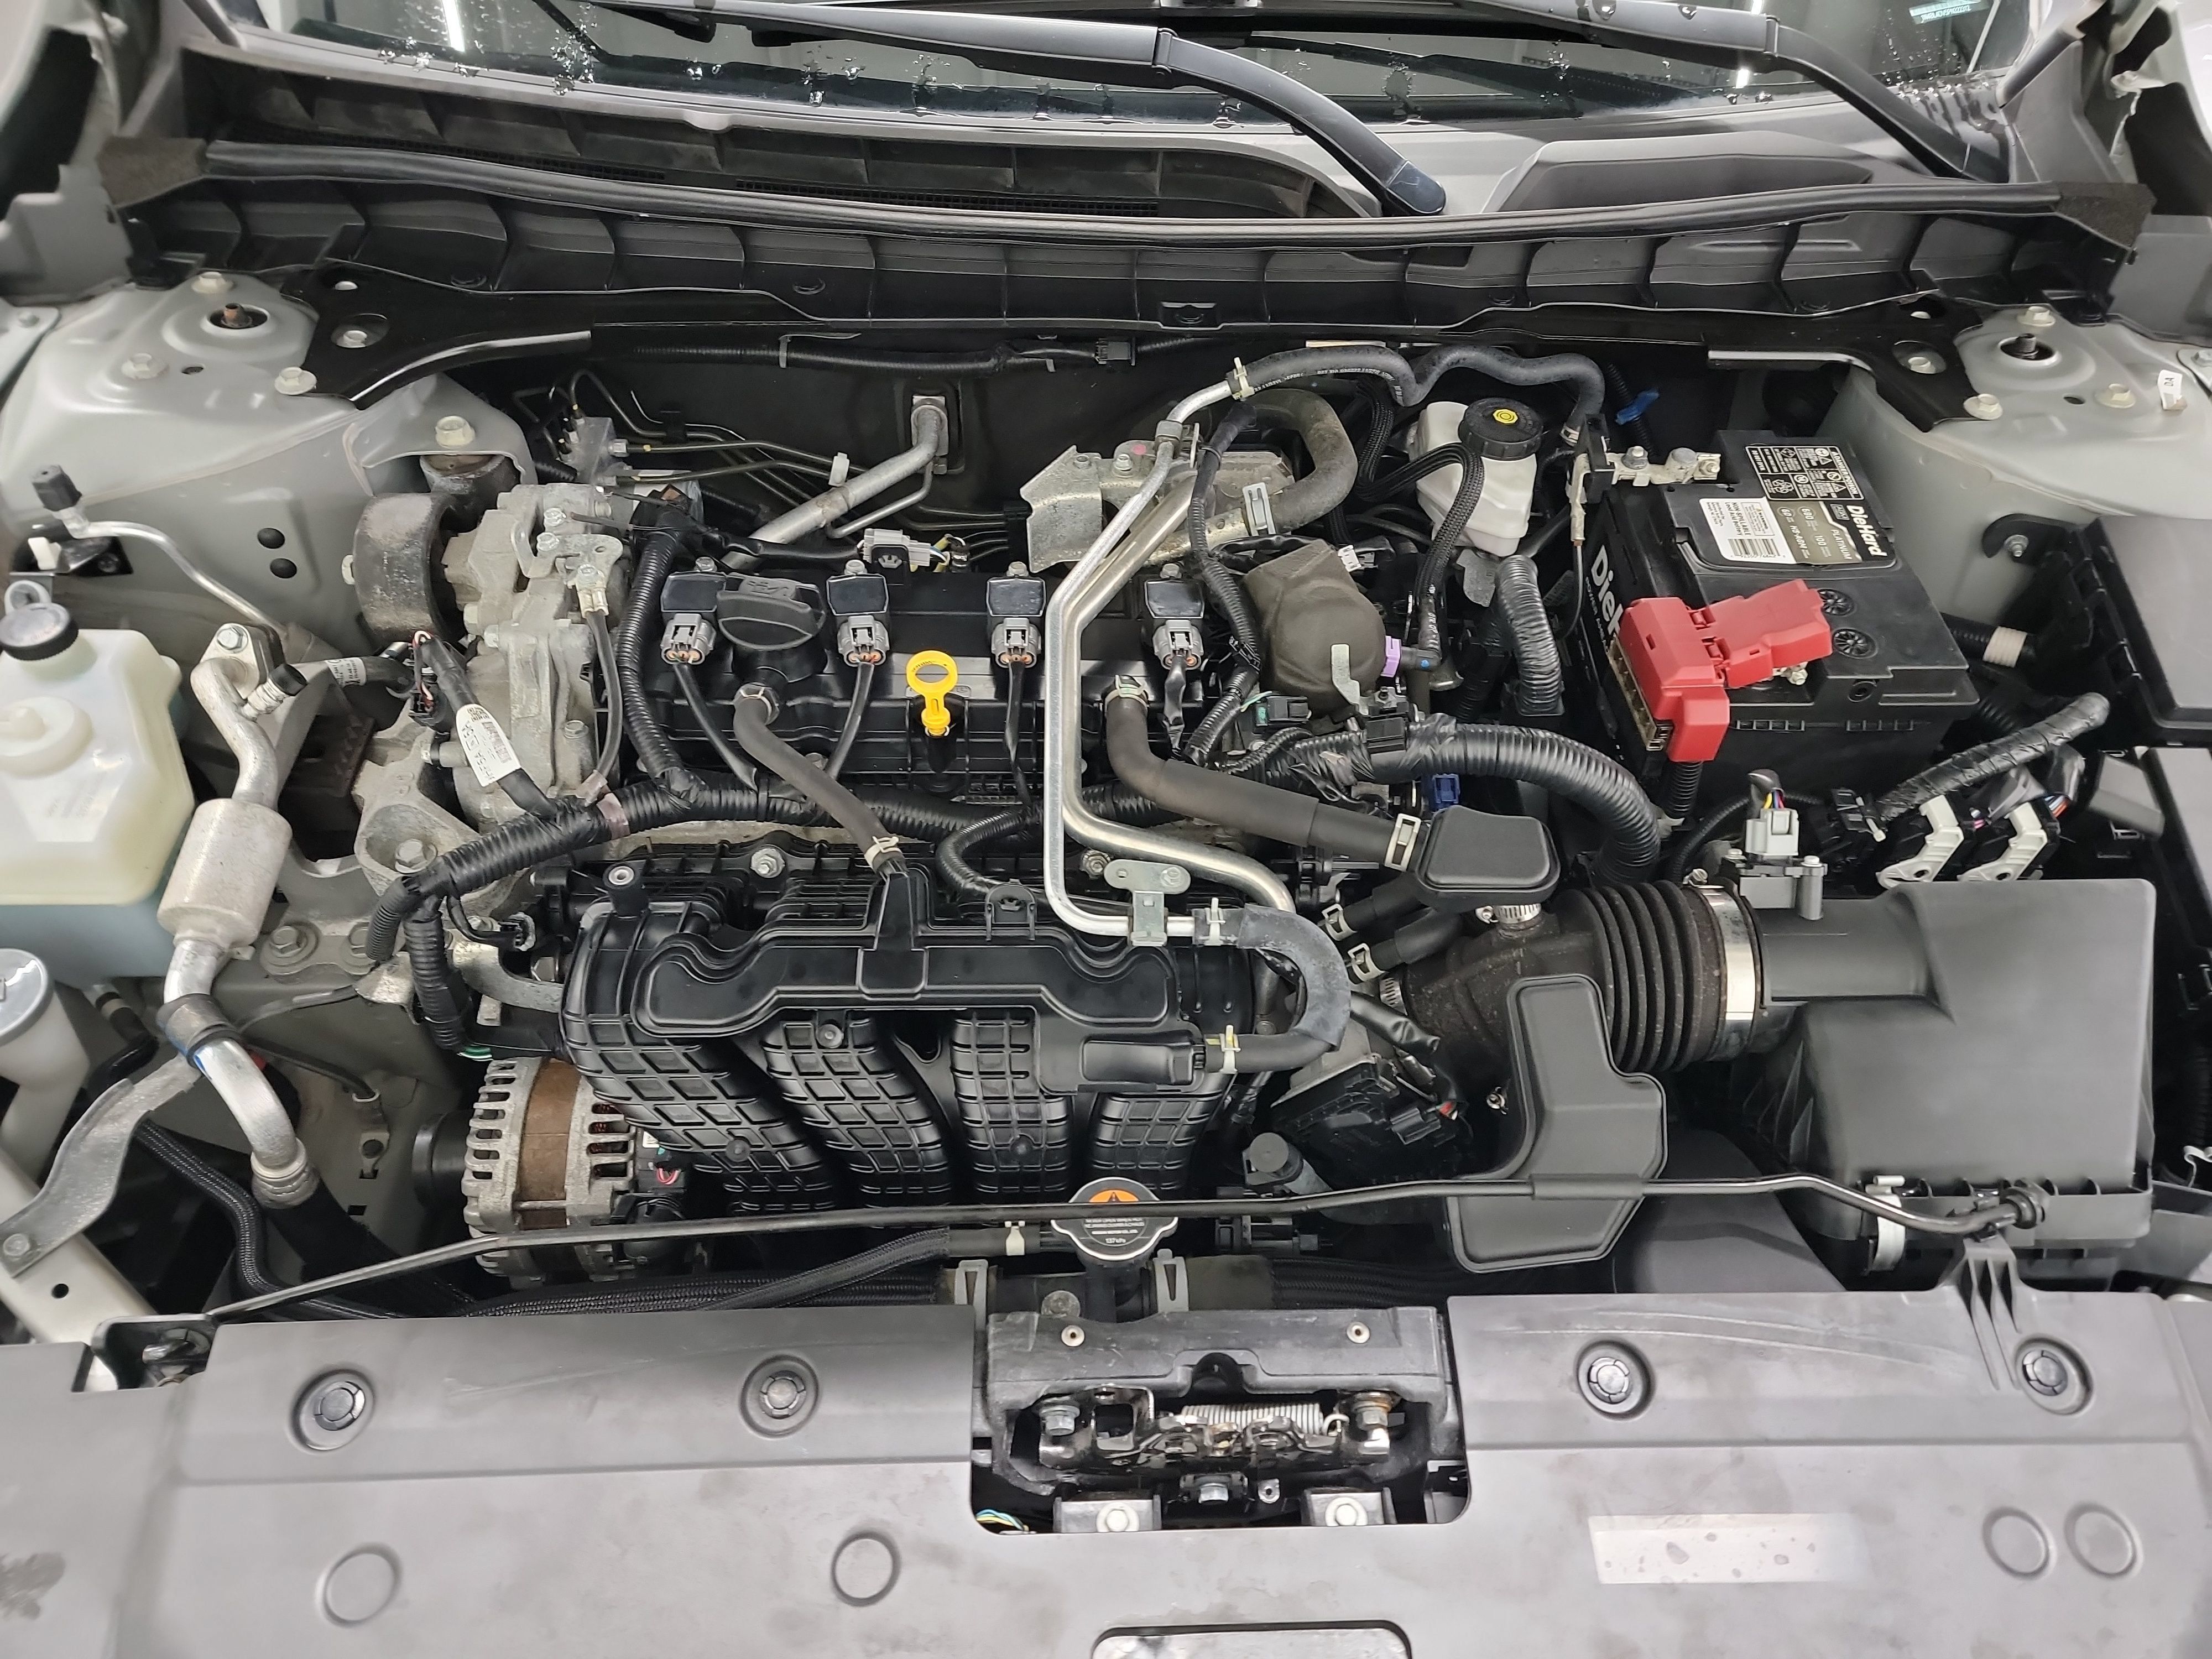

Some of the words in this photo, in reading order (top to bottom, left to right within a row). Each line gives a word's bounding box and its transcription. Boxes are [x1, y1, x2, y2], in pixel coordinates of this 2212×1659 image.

[1814, 535, 1827, 546] 100
[1830, 529, 1853, 560] PLATINUM
[1846, 505, 1887, 556] DieHard
[1591, 544, 1624, 635] DieH
